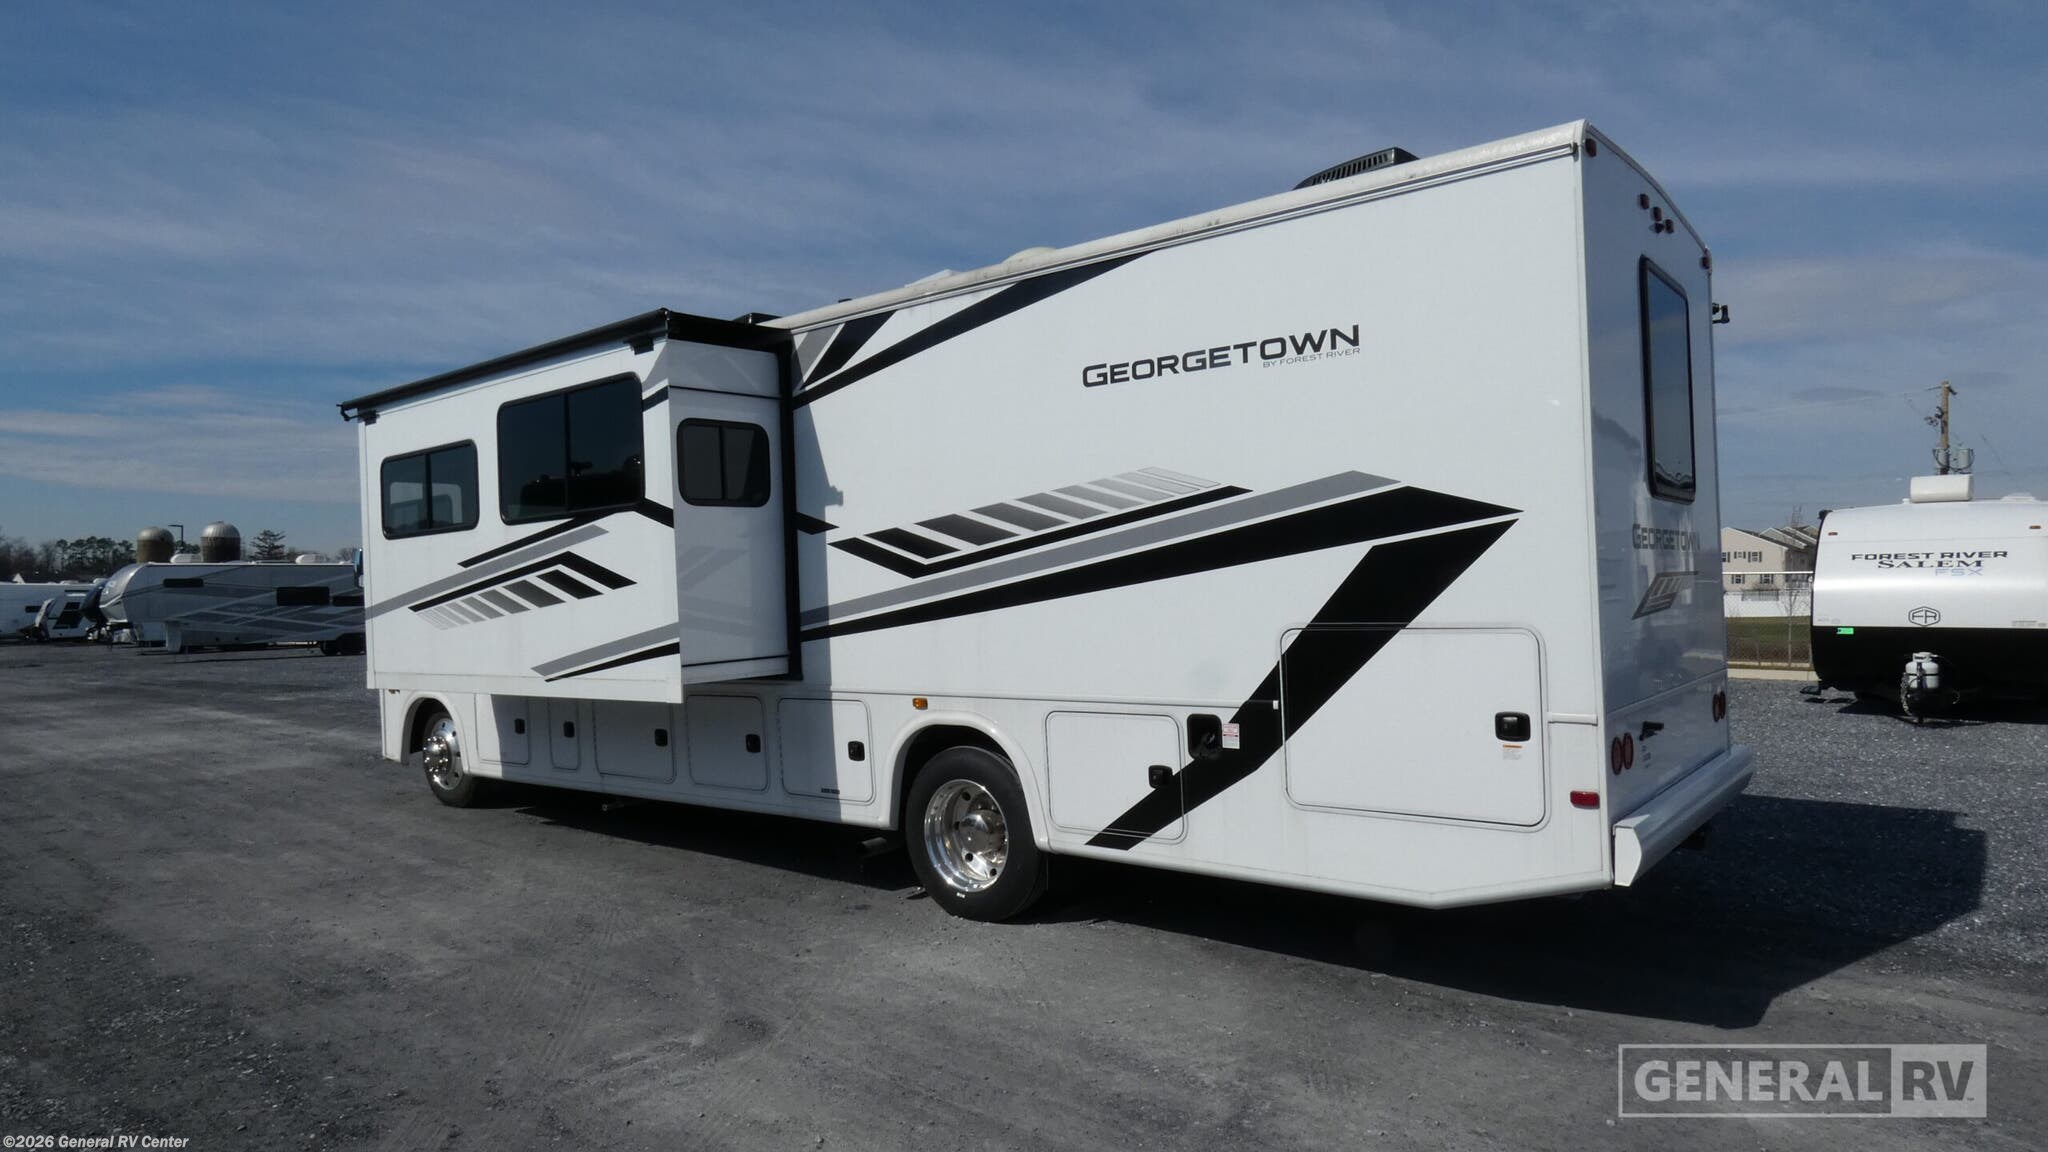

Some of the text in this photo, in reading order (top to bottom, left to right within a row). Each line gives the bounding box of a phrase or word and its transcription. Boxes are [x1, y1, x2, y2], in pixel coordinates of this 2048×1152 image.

[1082, 324, 1360, 388] GEORGETOWN
[1262, 347, 1361, 369] BY FOREST RIVER
[1632, 523, 1700, 552] GEORGETOWN
[1851, 550, 2008, 561] FOREST RIVER
[1877, 559, 1984, 569] SALEM
[1935, 568, 1984, 577] FSX
